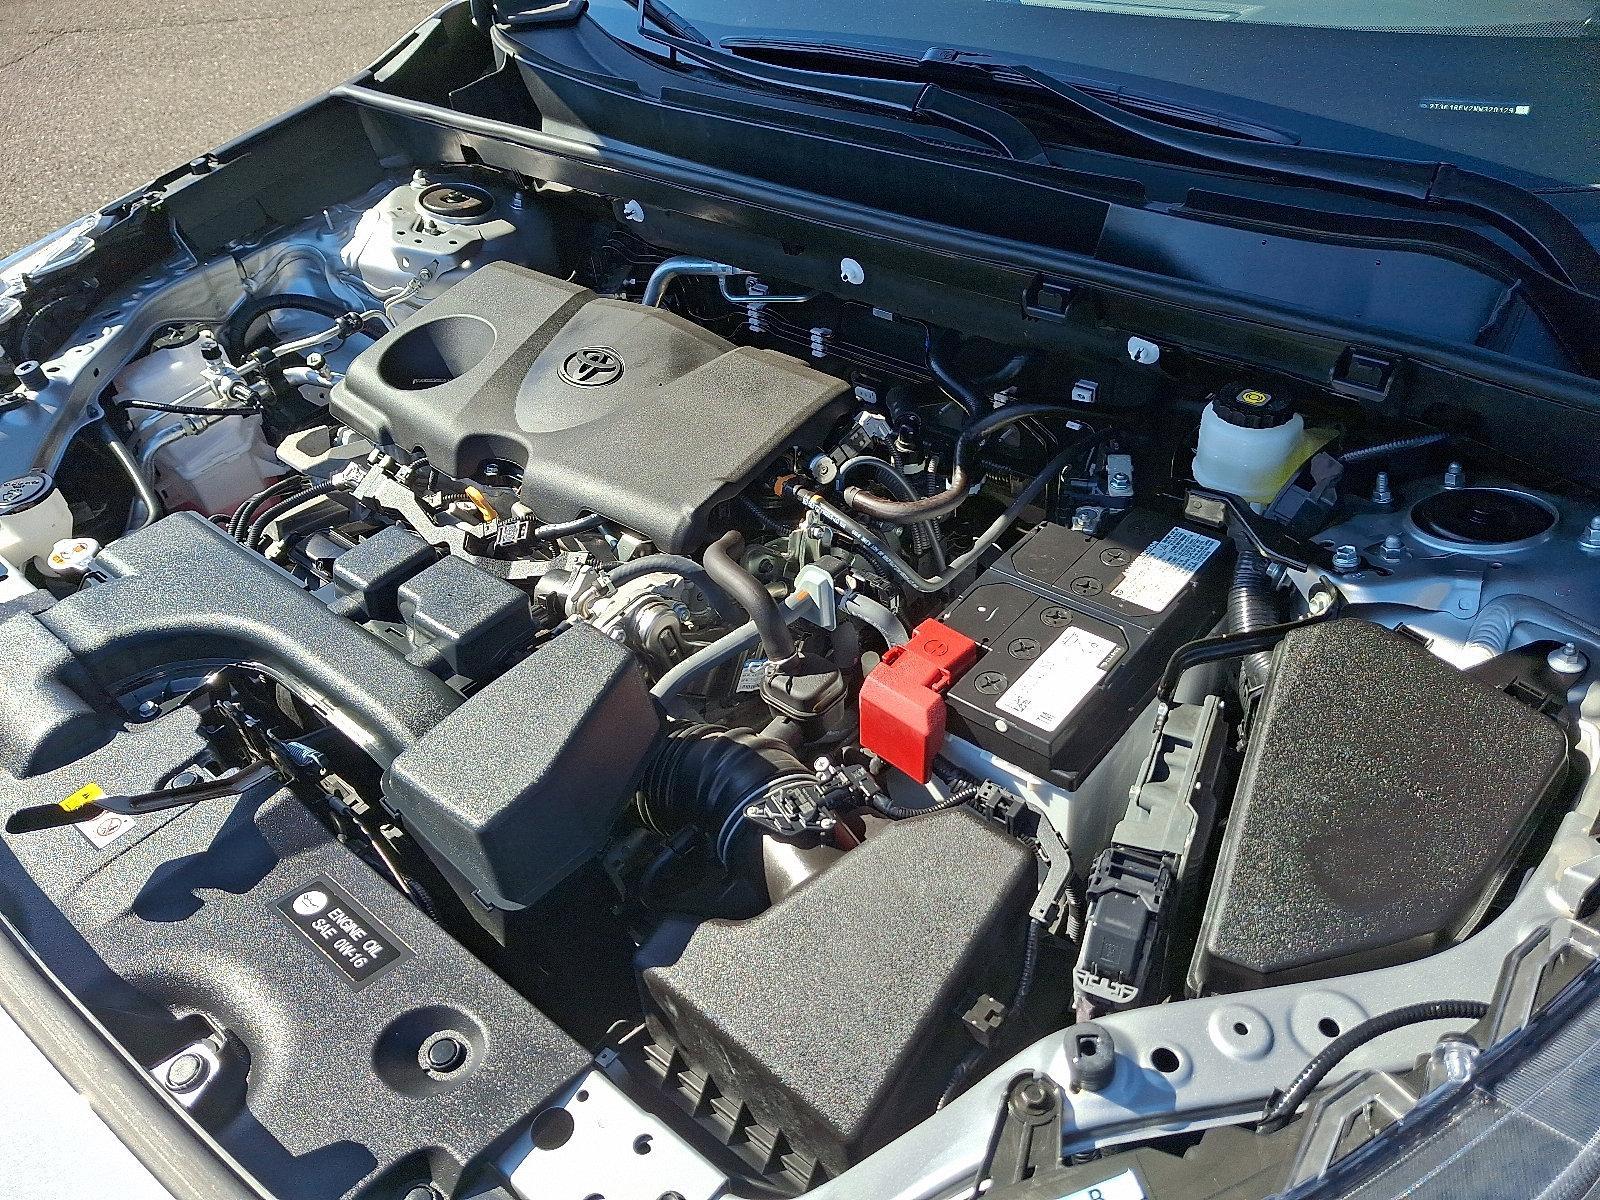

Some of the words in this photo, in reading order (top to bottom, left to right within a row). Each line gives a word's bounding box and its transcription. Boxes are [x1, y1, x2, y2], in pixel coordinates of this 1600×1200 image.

[311, 918, 338, 940] SAE
[333, 938, 368, 969] 0W-16
[327, 907, 368, 941] ENGINE
[362, 939, 384, 959] OIL
